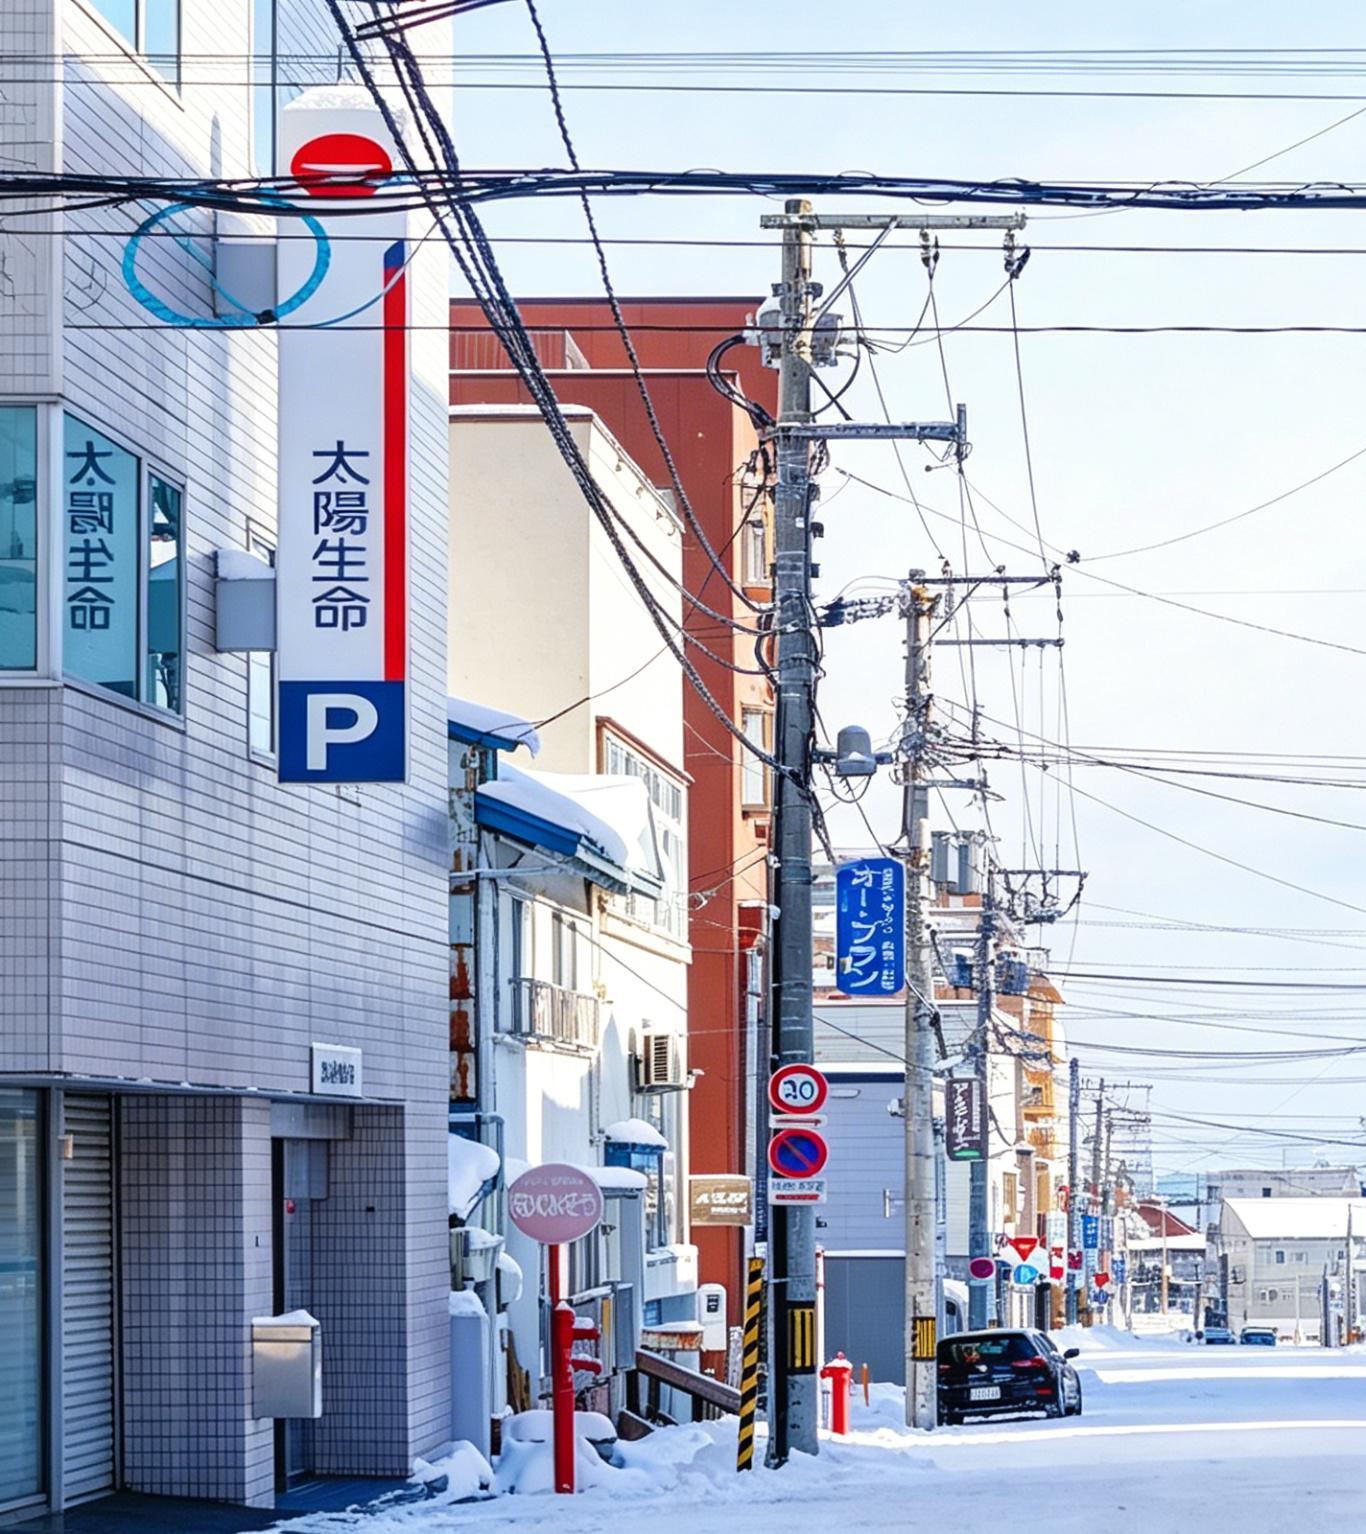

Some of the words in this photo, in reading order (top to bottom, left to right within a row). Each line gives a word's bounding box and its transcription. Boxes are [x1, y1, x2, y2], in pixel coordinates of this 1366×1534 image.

[312, 440, 371, 632] 太陽生命
[307, 693, 378, 770] P
